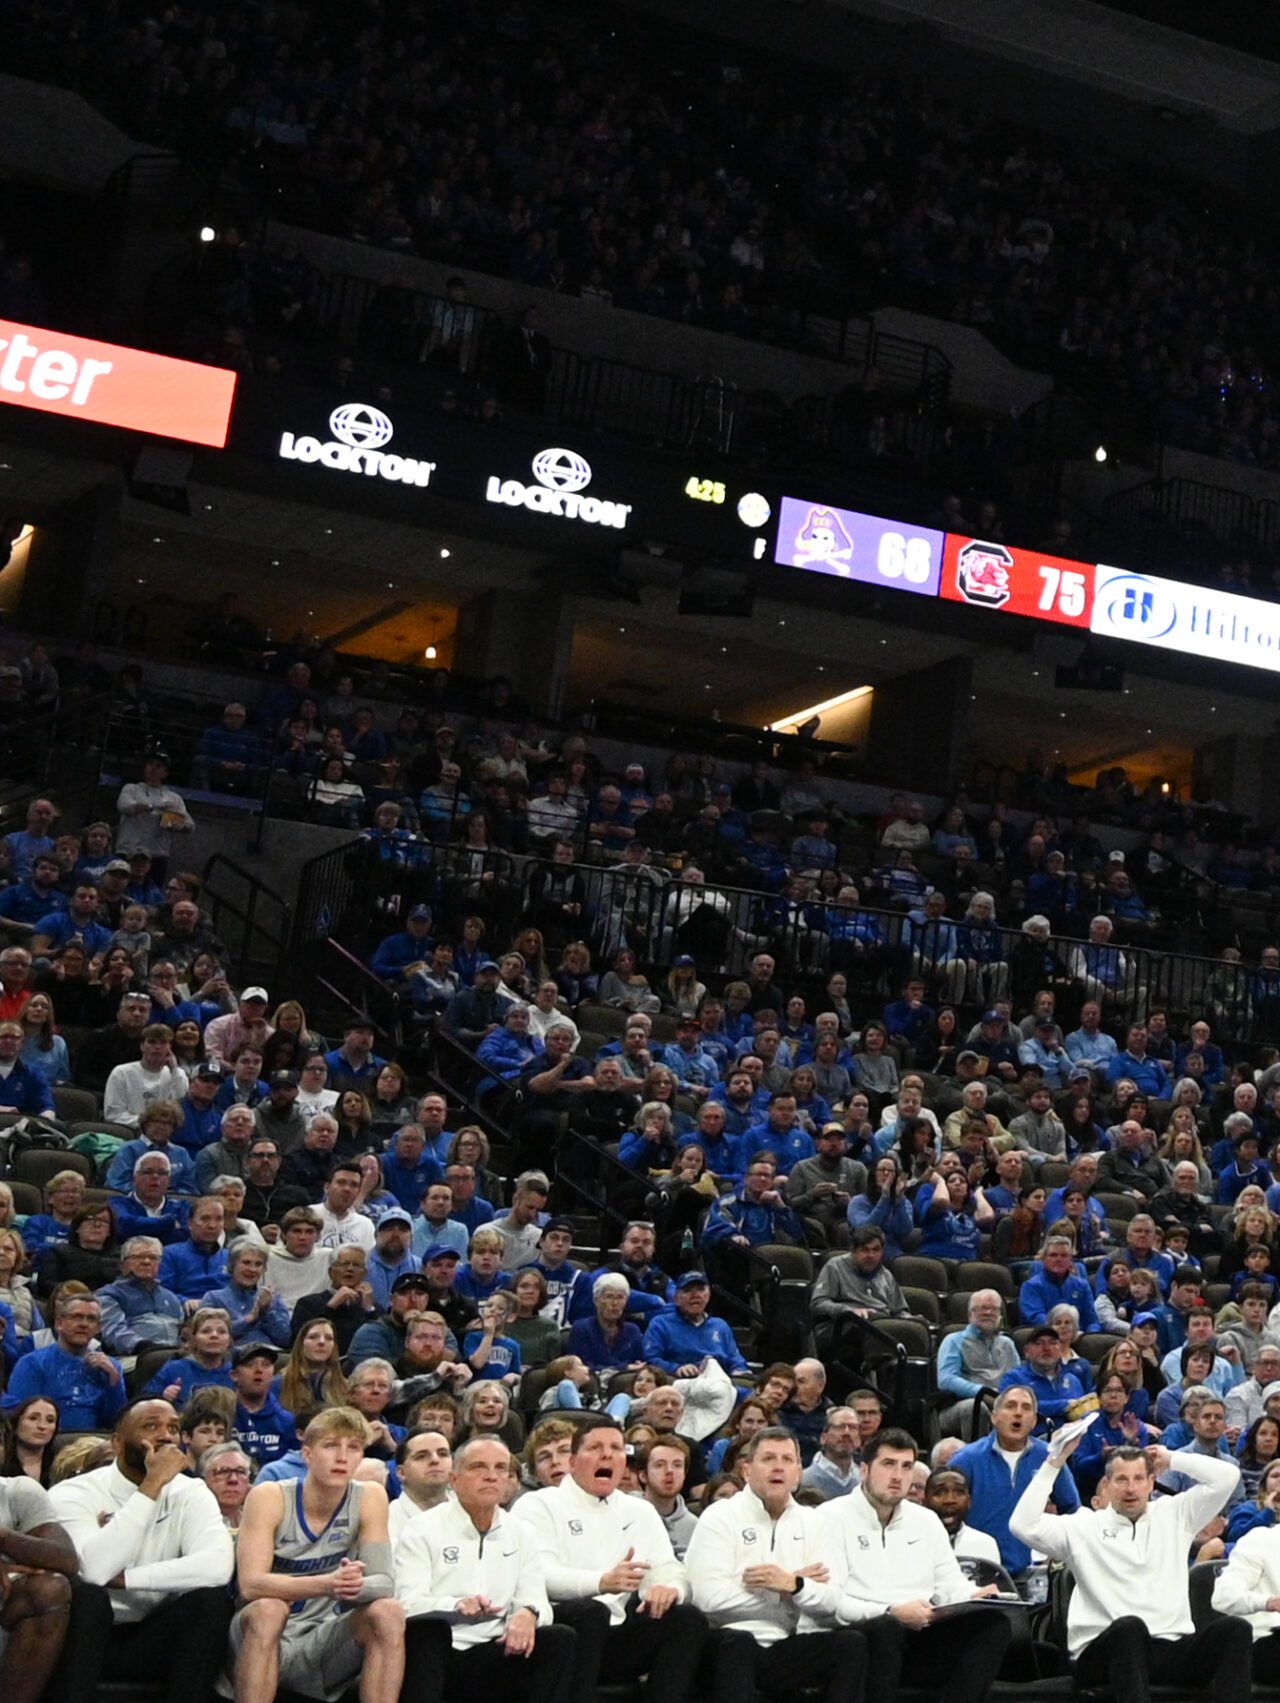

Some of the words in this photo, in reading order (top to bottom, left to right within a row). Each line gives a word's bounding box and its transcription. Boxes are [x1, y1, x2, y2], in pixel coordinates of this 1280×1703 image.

[0, 333, 113, 406] ter
[279, 431, 437, 488] LOCKTON
[485, 475, 633, 529] LOCKTON
[877, 531, 932, 584] 68
[1038, 565, 1087, 617] 75
